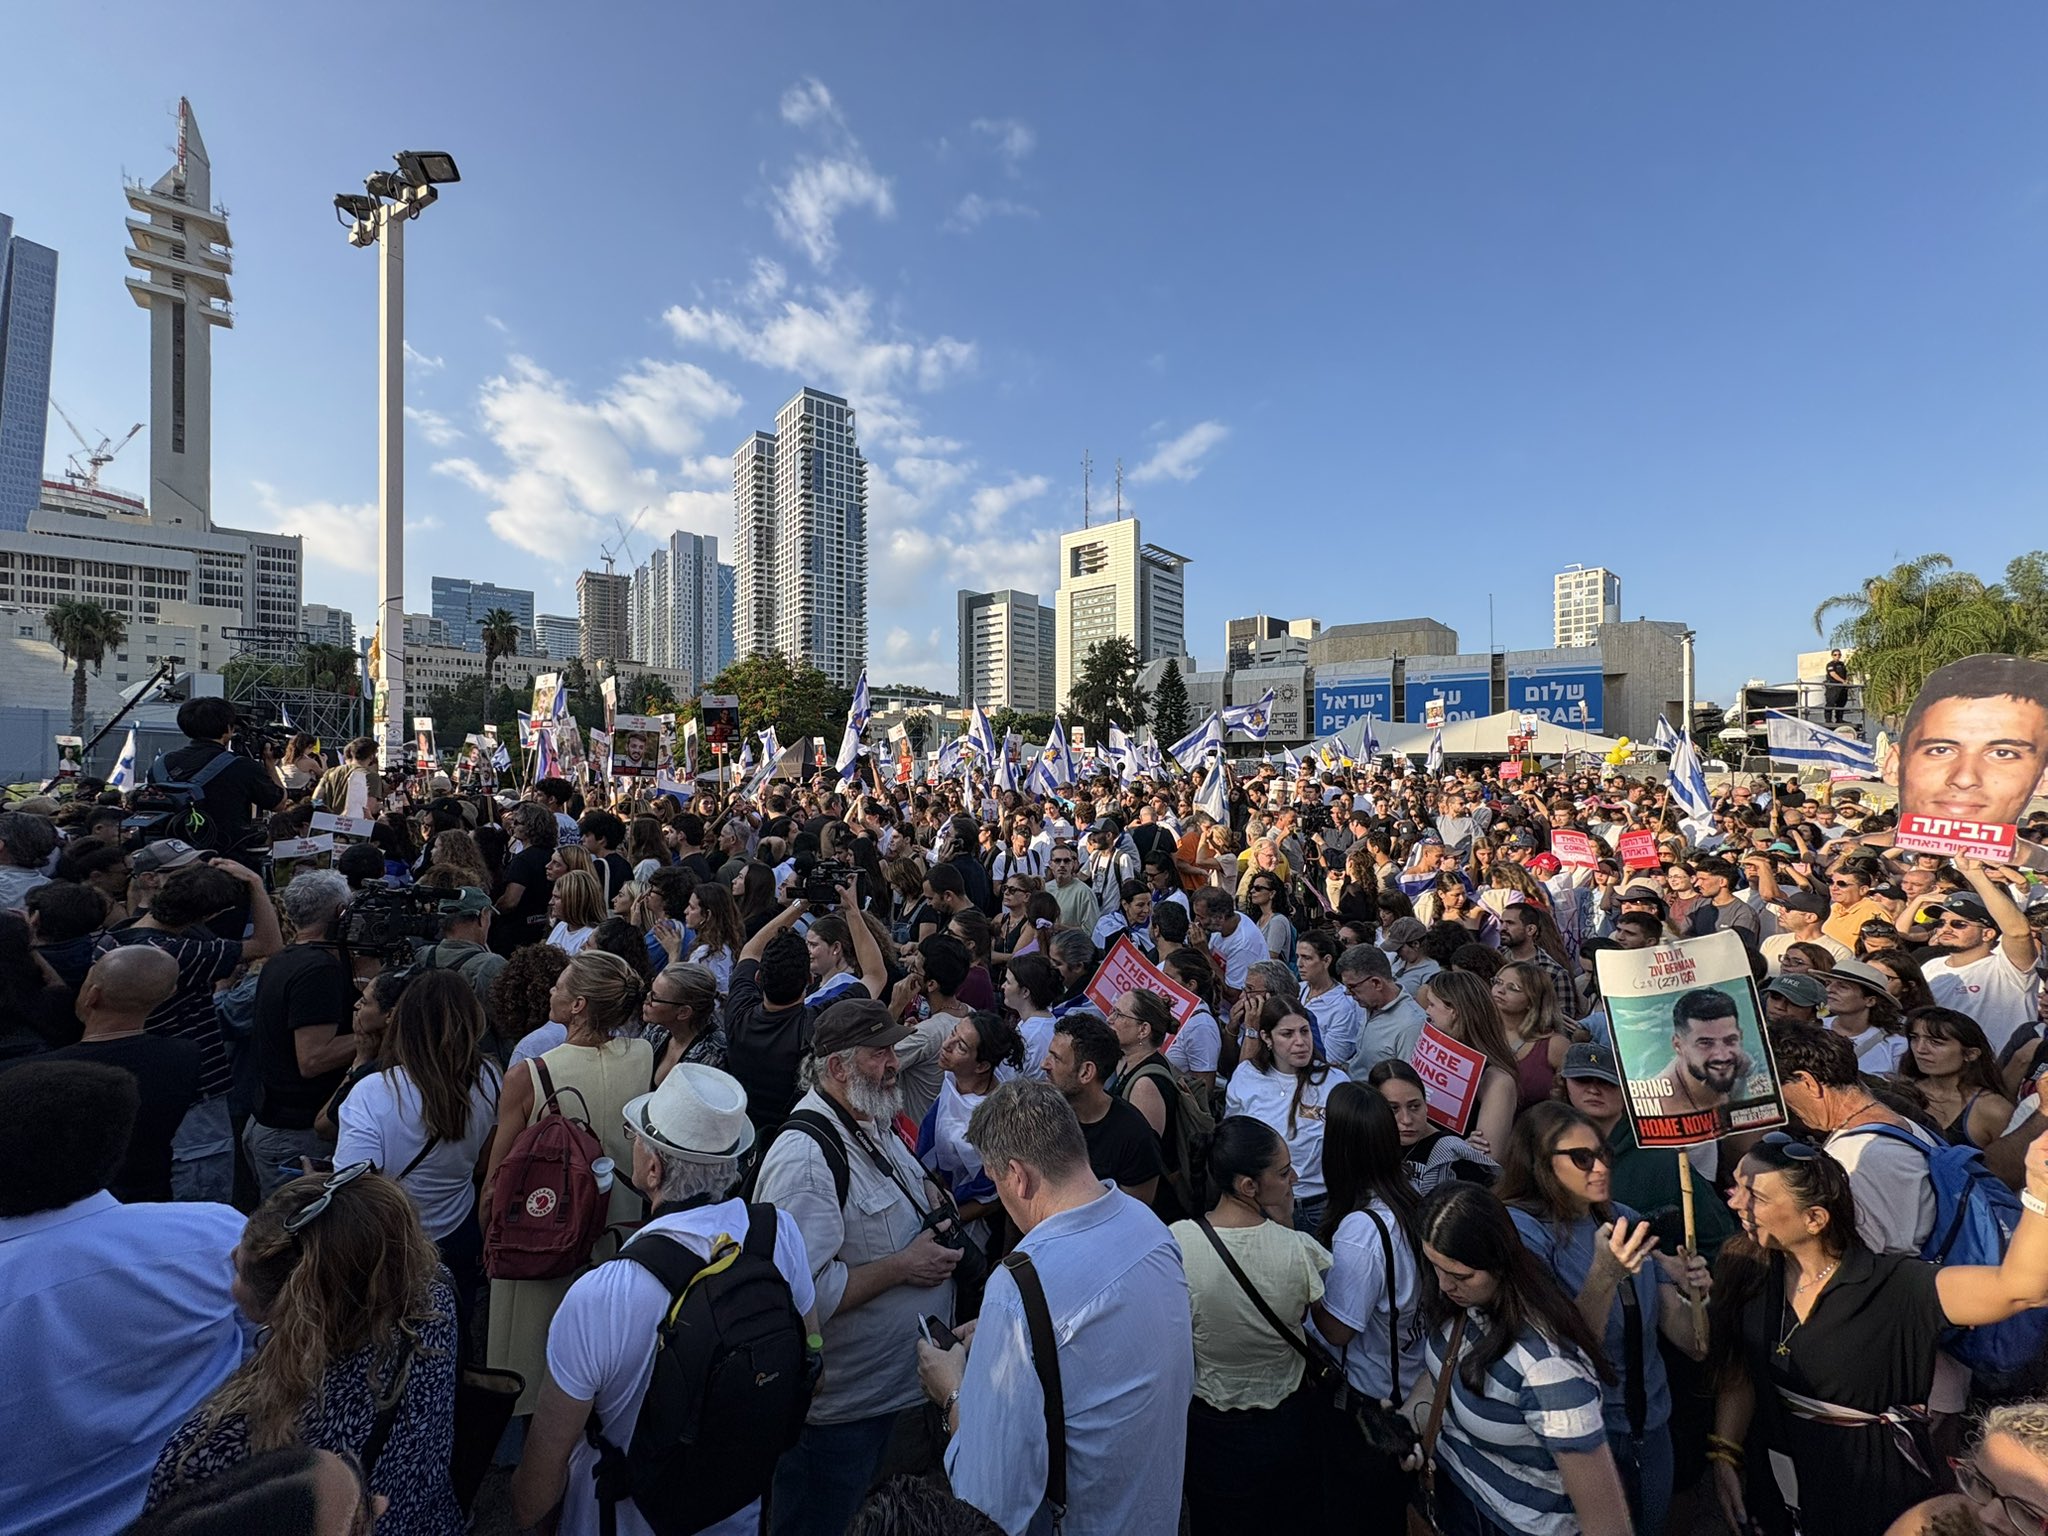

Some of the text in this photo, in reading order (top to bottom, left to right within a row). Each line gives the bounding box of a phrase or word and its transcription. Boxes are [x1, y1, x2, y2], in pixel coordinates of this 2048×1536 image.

[1322, 692, 1383, 710] ישראל
[1433, 688, 1461, 705] על
[1525, 682, 1585, 702] שלום
[1322, 713, 1383, 730] PEA
[1517, 706, 1596, 723] RAEL
[1911, 817, 2004, 842] הביתה
[1648, 958, 1696, 977] ZIV BERMAN
[1657, 975, 1680, 990] (27)
[1418, 1037, 1461, 1072] EY'RE
[1411, 1054, 1448, 1088] MING
[1627, 1078, 1674, 1098] BRING
[1631, 1098, 1663, 1117] HIM
[1637, 1118, 1682, 1137] HOME
[855, 1130, 874, 1153] Canon
